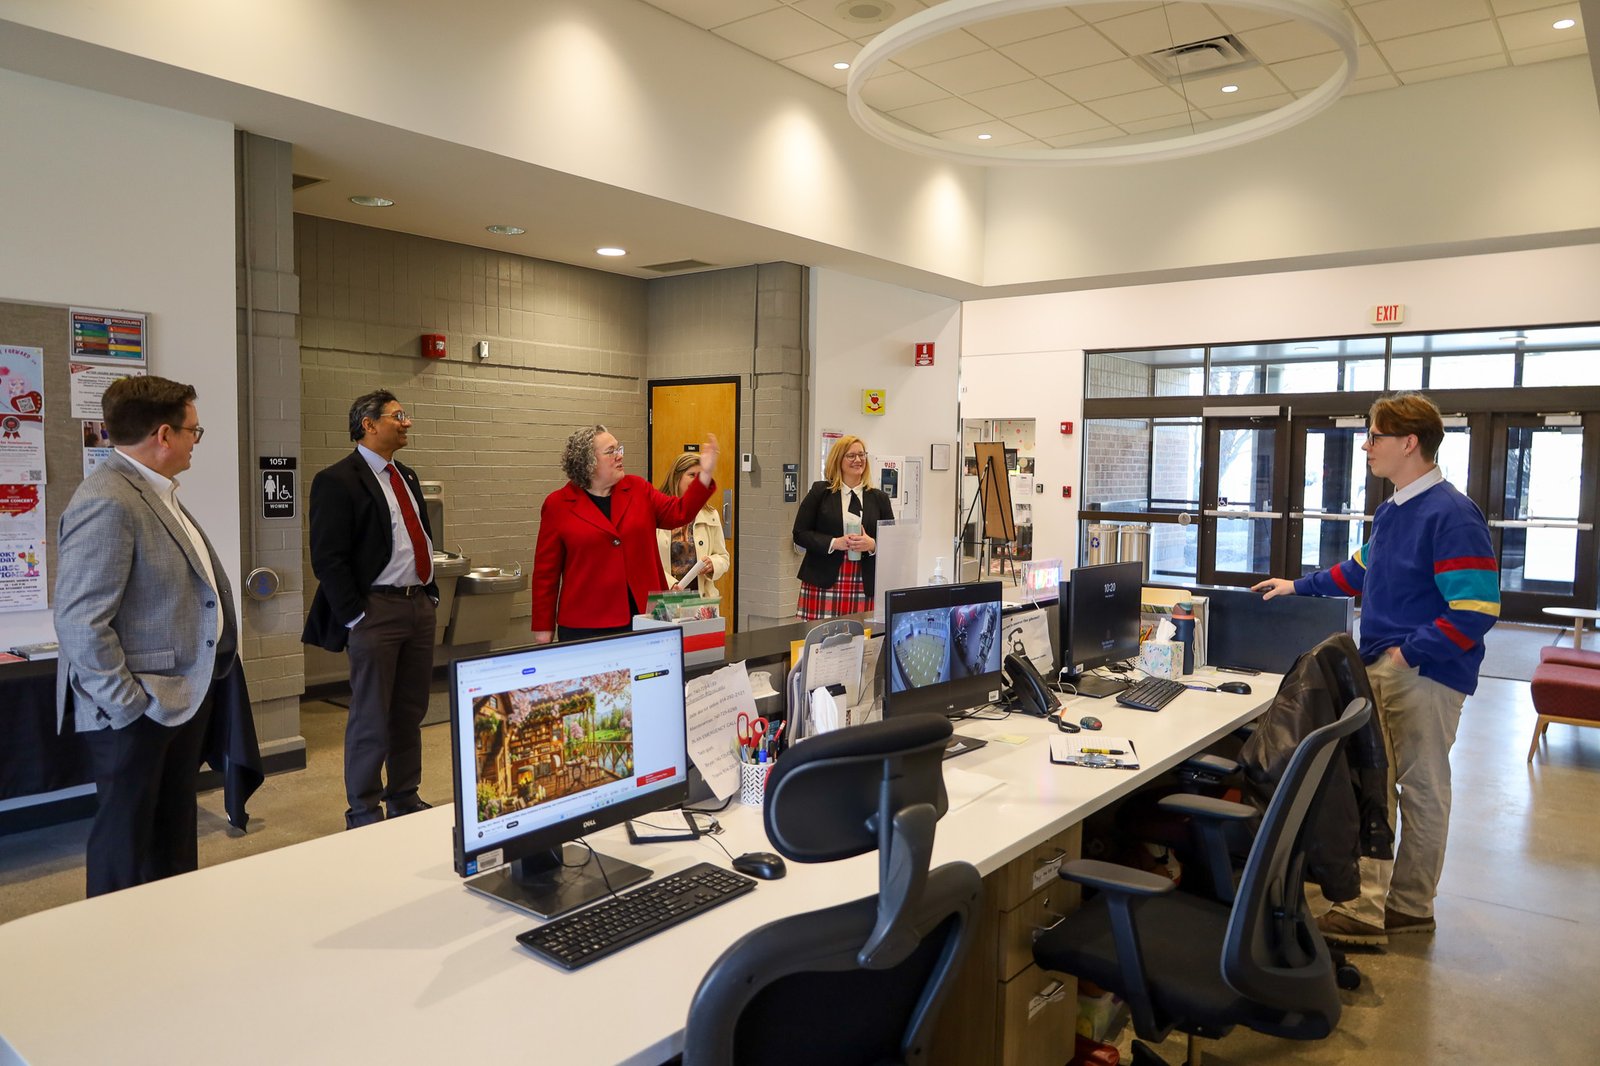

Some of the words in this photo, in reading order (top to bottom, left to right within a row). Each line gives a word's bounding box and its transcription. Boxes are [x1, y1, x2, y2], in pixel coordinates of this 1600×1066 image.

[1376, 305, 1399, 322] EXIT
[1104, 582, 1116, 593] 10:20
[583, 819, 597, 829] DELL
